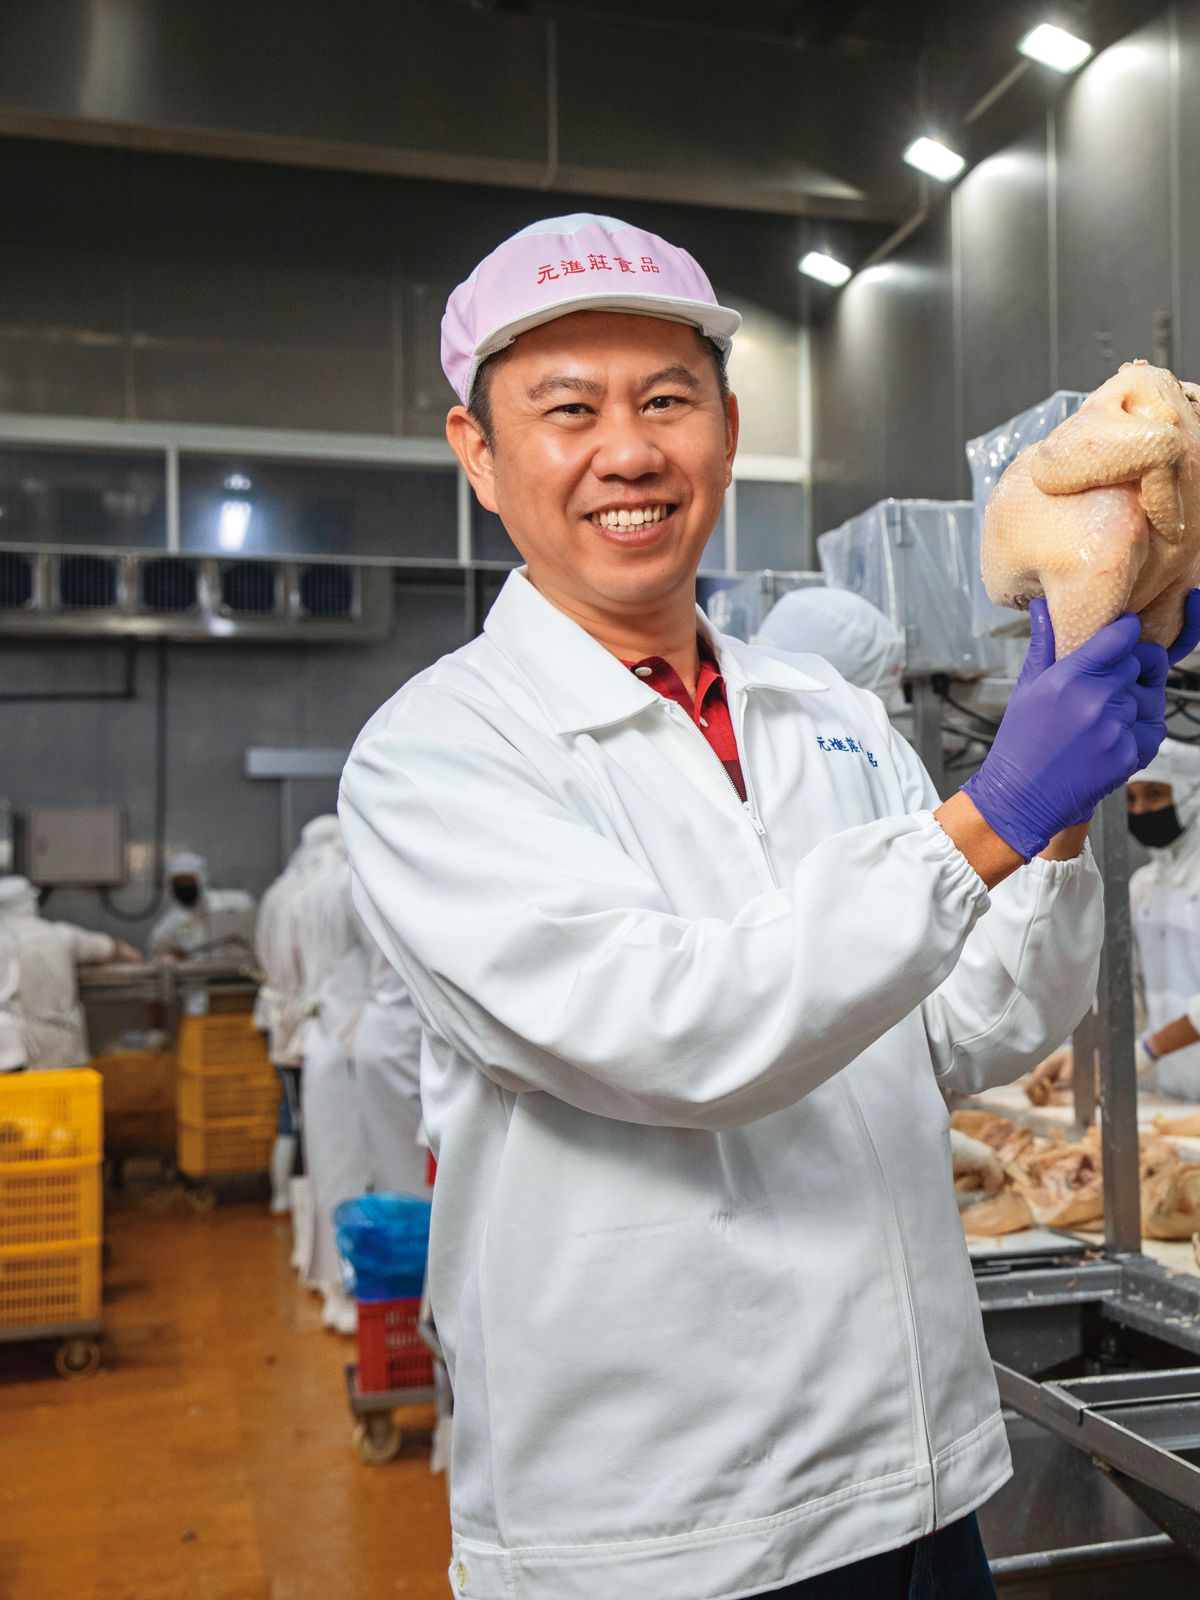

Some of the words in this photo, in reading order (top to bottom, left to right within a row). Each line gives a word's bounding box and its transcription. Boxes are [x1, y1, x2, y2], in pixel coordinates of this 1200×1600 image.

[537, 253, 660, 284] 元進莊食品
[816, 736, 879, 768] 元進莊品
